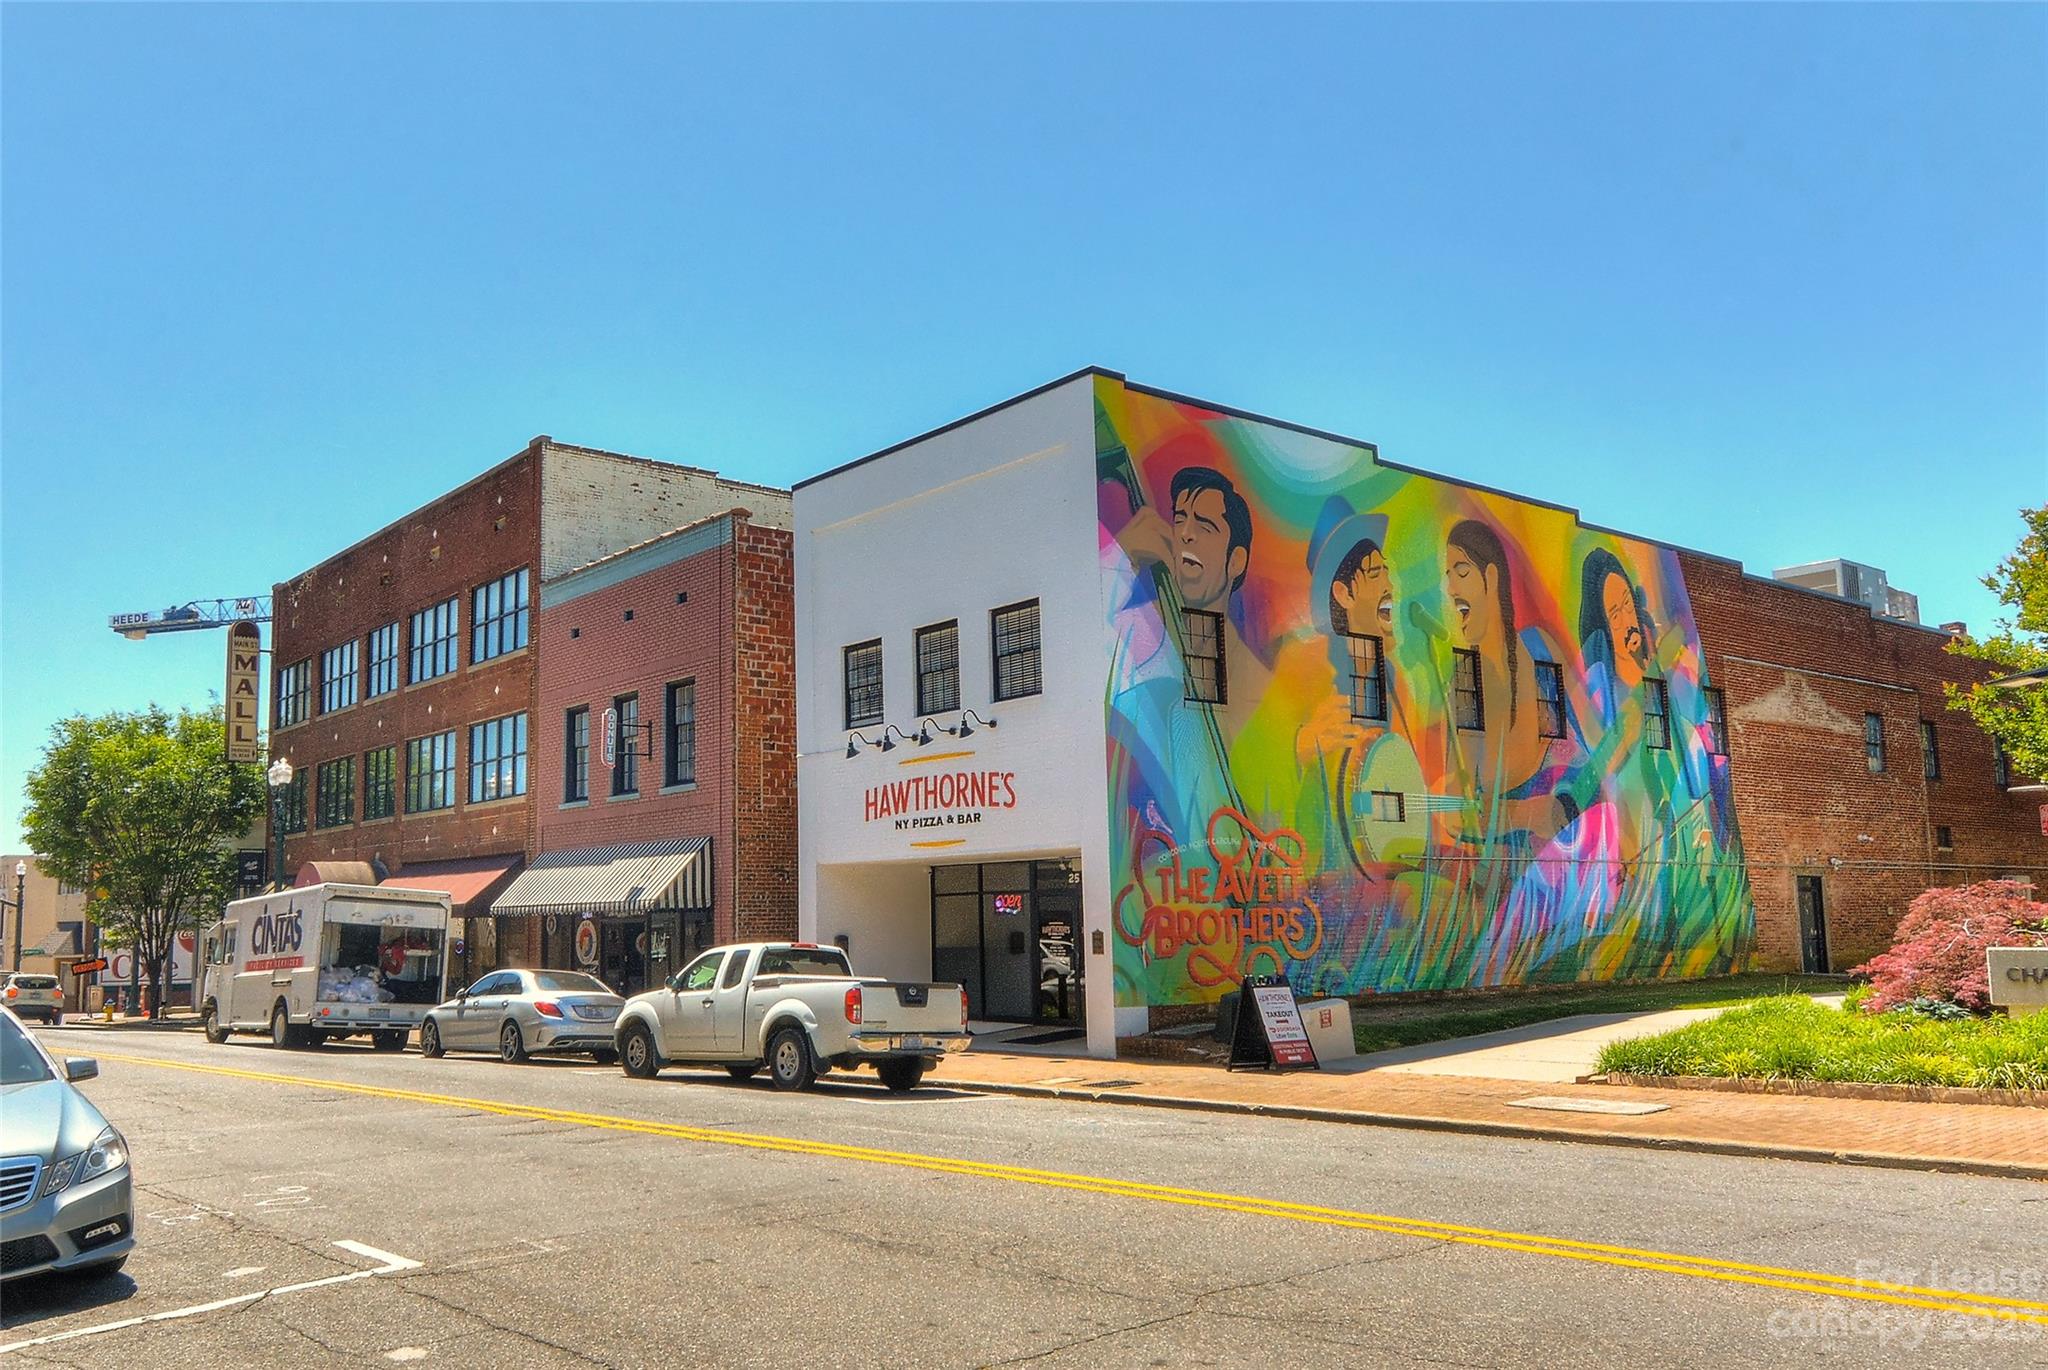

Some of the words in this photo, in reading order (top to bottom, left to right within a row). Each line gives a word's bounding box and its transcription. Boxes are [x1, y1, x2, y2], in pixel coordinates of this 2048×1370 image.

[113, 612, 149, 625] HEEDE
[234, 654, 257, 742] MALL
[607, 713, 616, 762] DONUTS
[864, 771, 1017, 822] HAWTHORNE'S
[894, 818, 910, 830] NY
[912, 814, 944, 828] PIZZA
[946, 815, 955, 825] &
[957, 812, 982, 825] BAR
[1155, 866, 1212, 904] THE
[1213, 862, 1305, 904] AVETT
[252, 897, 303, 955] CINTAS
[1148, 906, 1305, 959] BROTHERS
[1266, 1010, 1294, 1018] TAKEOUT
